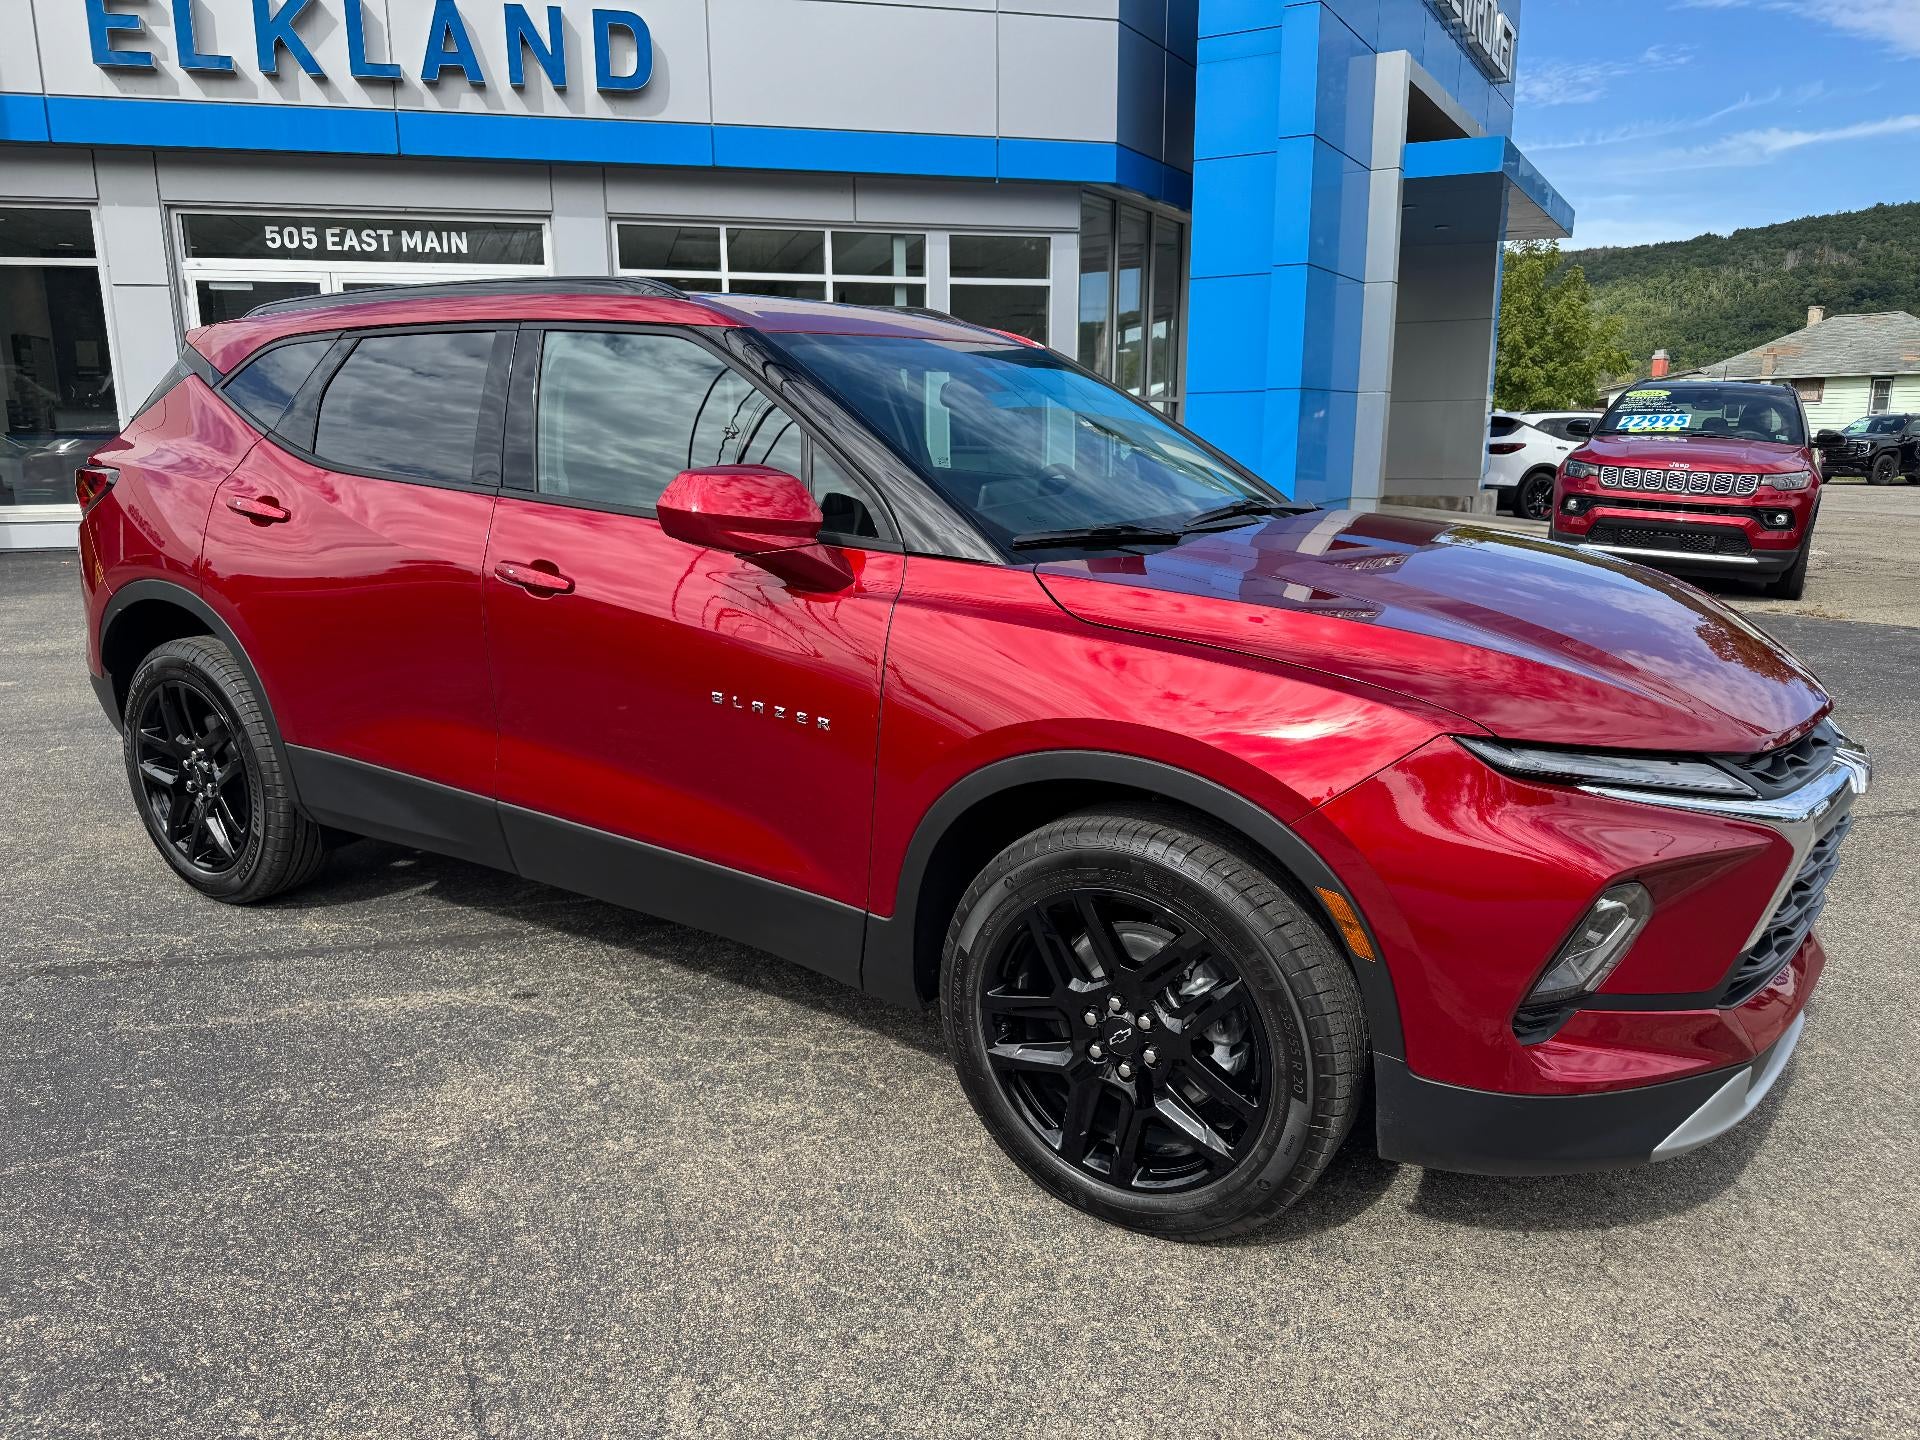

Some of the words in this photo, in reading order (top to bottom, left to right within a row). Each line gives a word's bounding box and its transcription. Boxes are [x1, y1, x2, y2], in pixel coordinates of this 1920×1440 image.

[86, 0, 654, 92] ELKLAND
[264, 225, 318, 250] 505
[325, 228, 394, 252] EAST
[401, 230, 469, 254] MAIN
[1618, 415, 1689, 428] 22995
[1669, 461, 1690, 469] Jeep
[711, 691, 831, 731] BLAZER
[1293, 1074, 1304, 1094] 20
